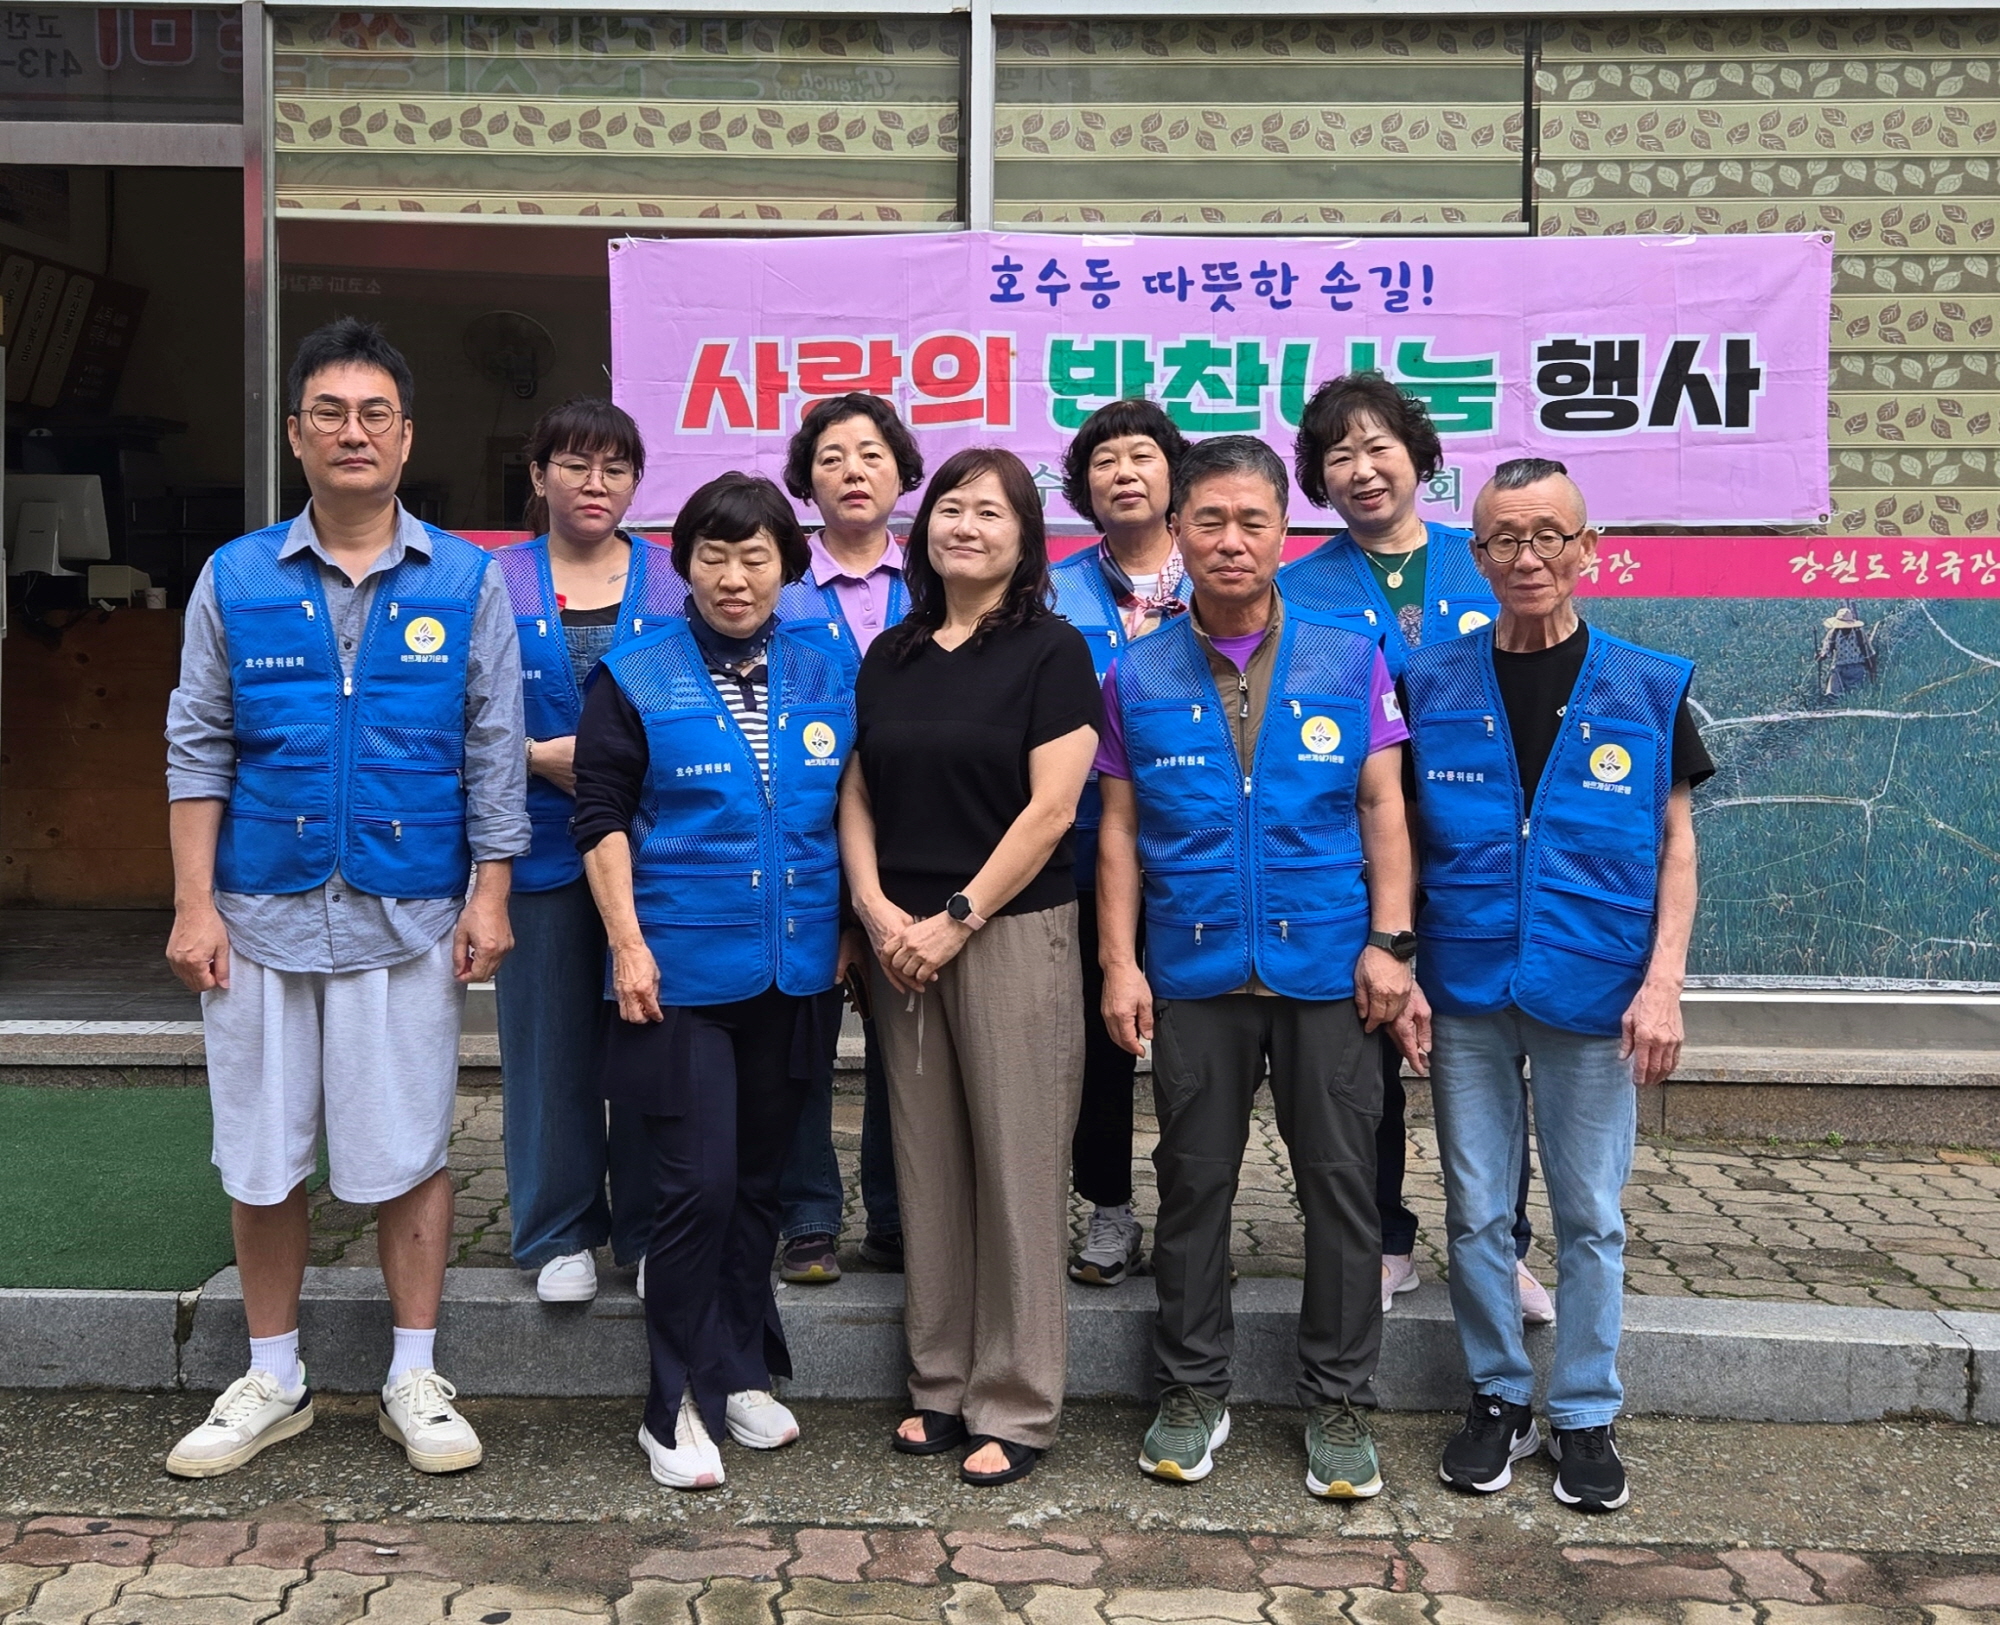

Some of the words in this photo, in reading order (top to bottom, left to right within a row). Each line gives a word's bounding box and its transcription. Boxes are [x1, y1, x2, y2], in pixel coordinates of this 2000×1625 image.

[990, 255, 1121, 309] 호수동
[1143, 260, 1299, 313] 따뜻한
[1320, 260, 1434, 313] 손길!
[679, 334, 1012, 432] 사랑의
[1046, 336, 1498, 434] 반찬나눔
[1535, 335, 1762, 432] 행사
[245, 656, 305, 669] 호수동위원회
[675, 762, 732, 777] 호수동위원회
[1426, 769, 1485, 783] 호수동위원회
